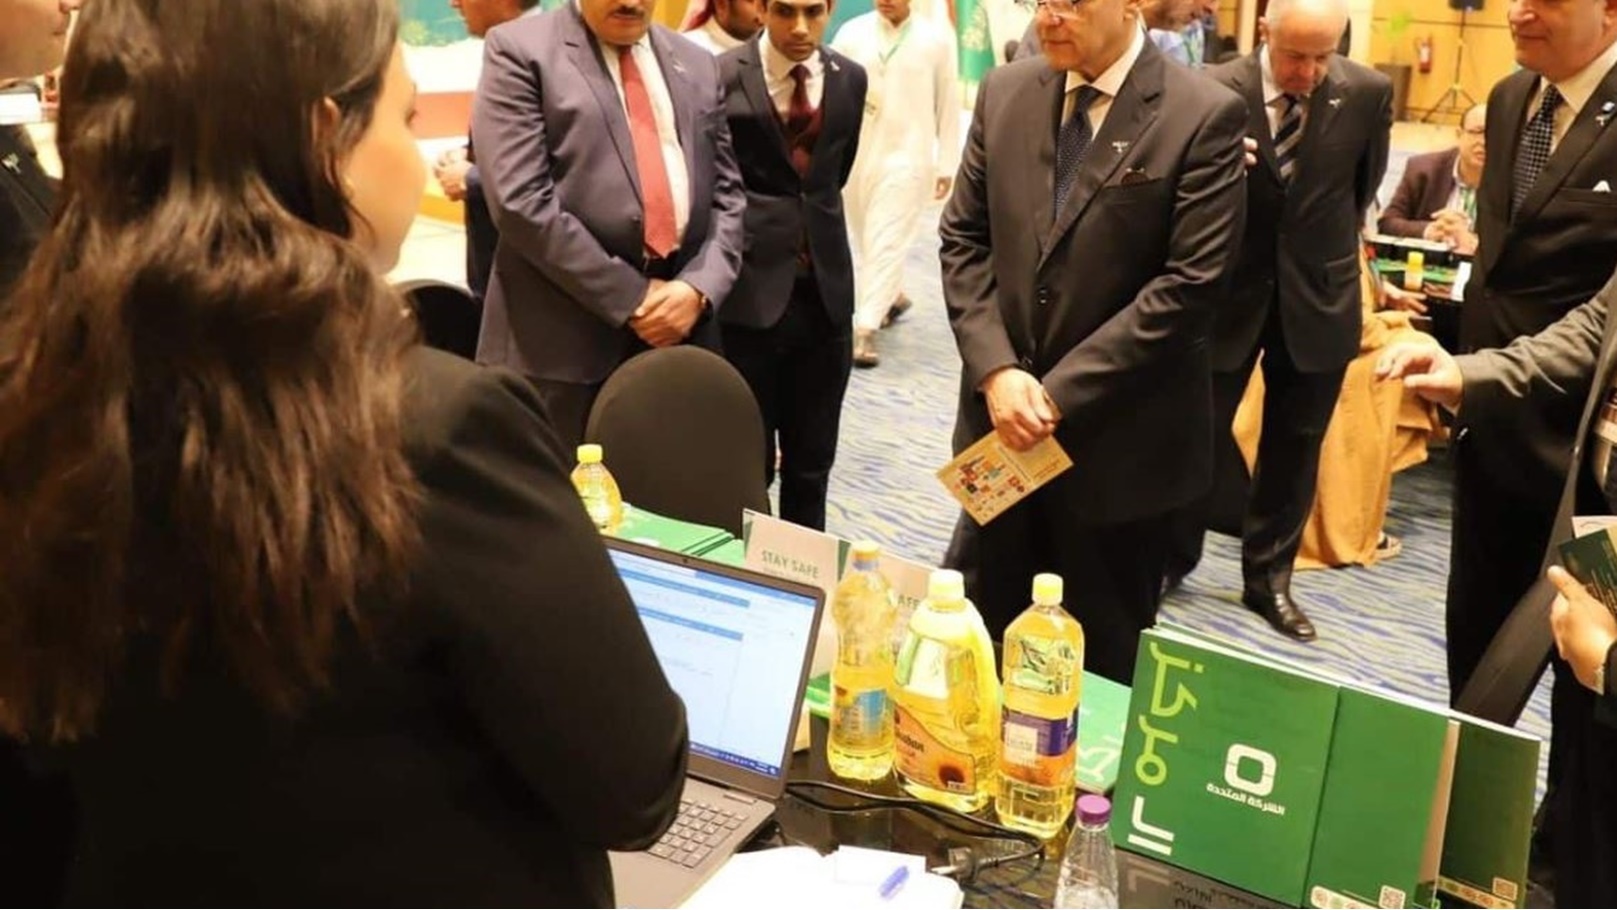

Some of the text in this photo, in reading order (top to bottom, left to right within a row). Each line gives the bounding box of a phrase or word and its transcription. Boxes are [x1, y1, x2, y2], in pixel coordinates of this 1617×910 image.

[762, 549, 787, 569] STAY
[791, 559, 819, 578] SAFE
[1206, 782, 1286, 816] الشركة المتحدة
